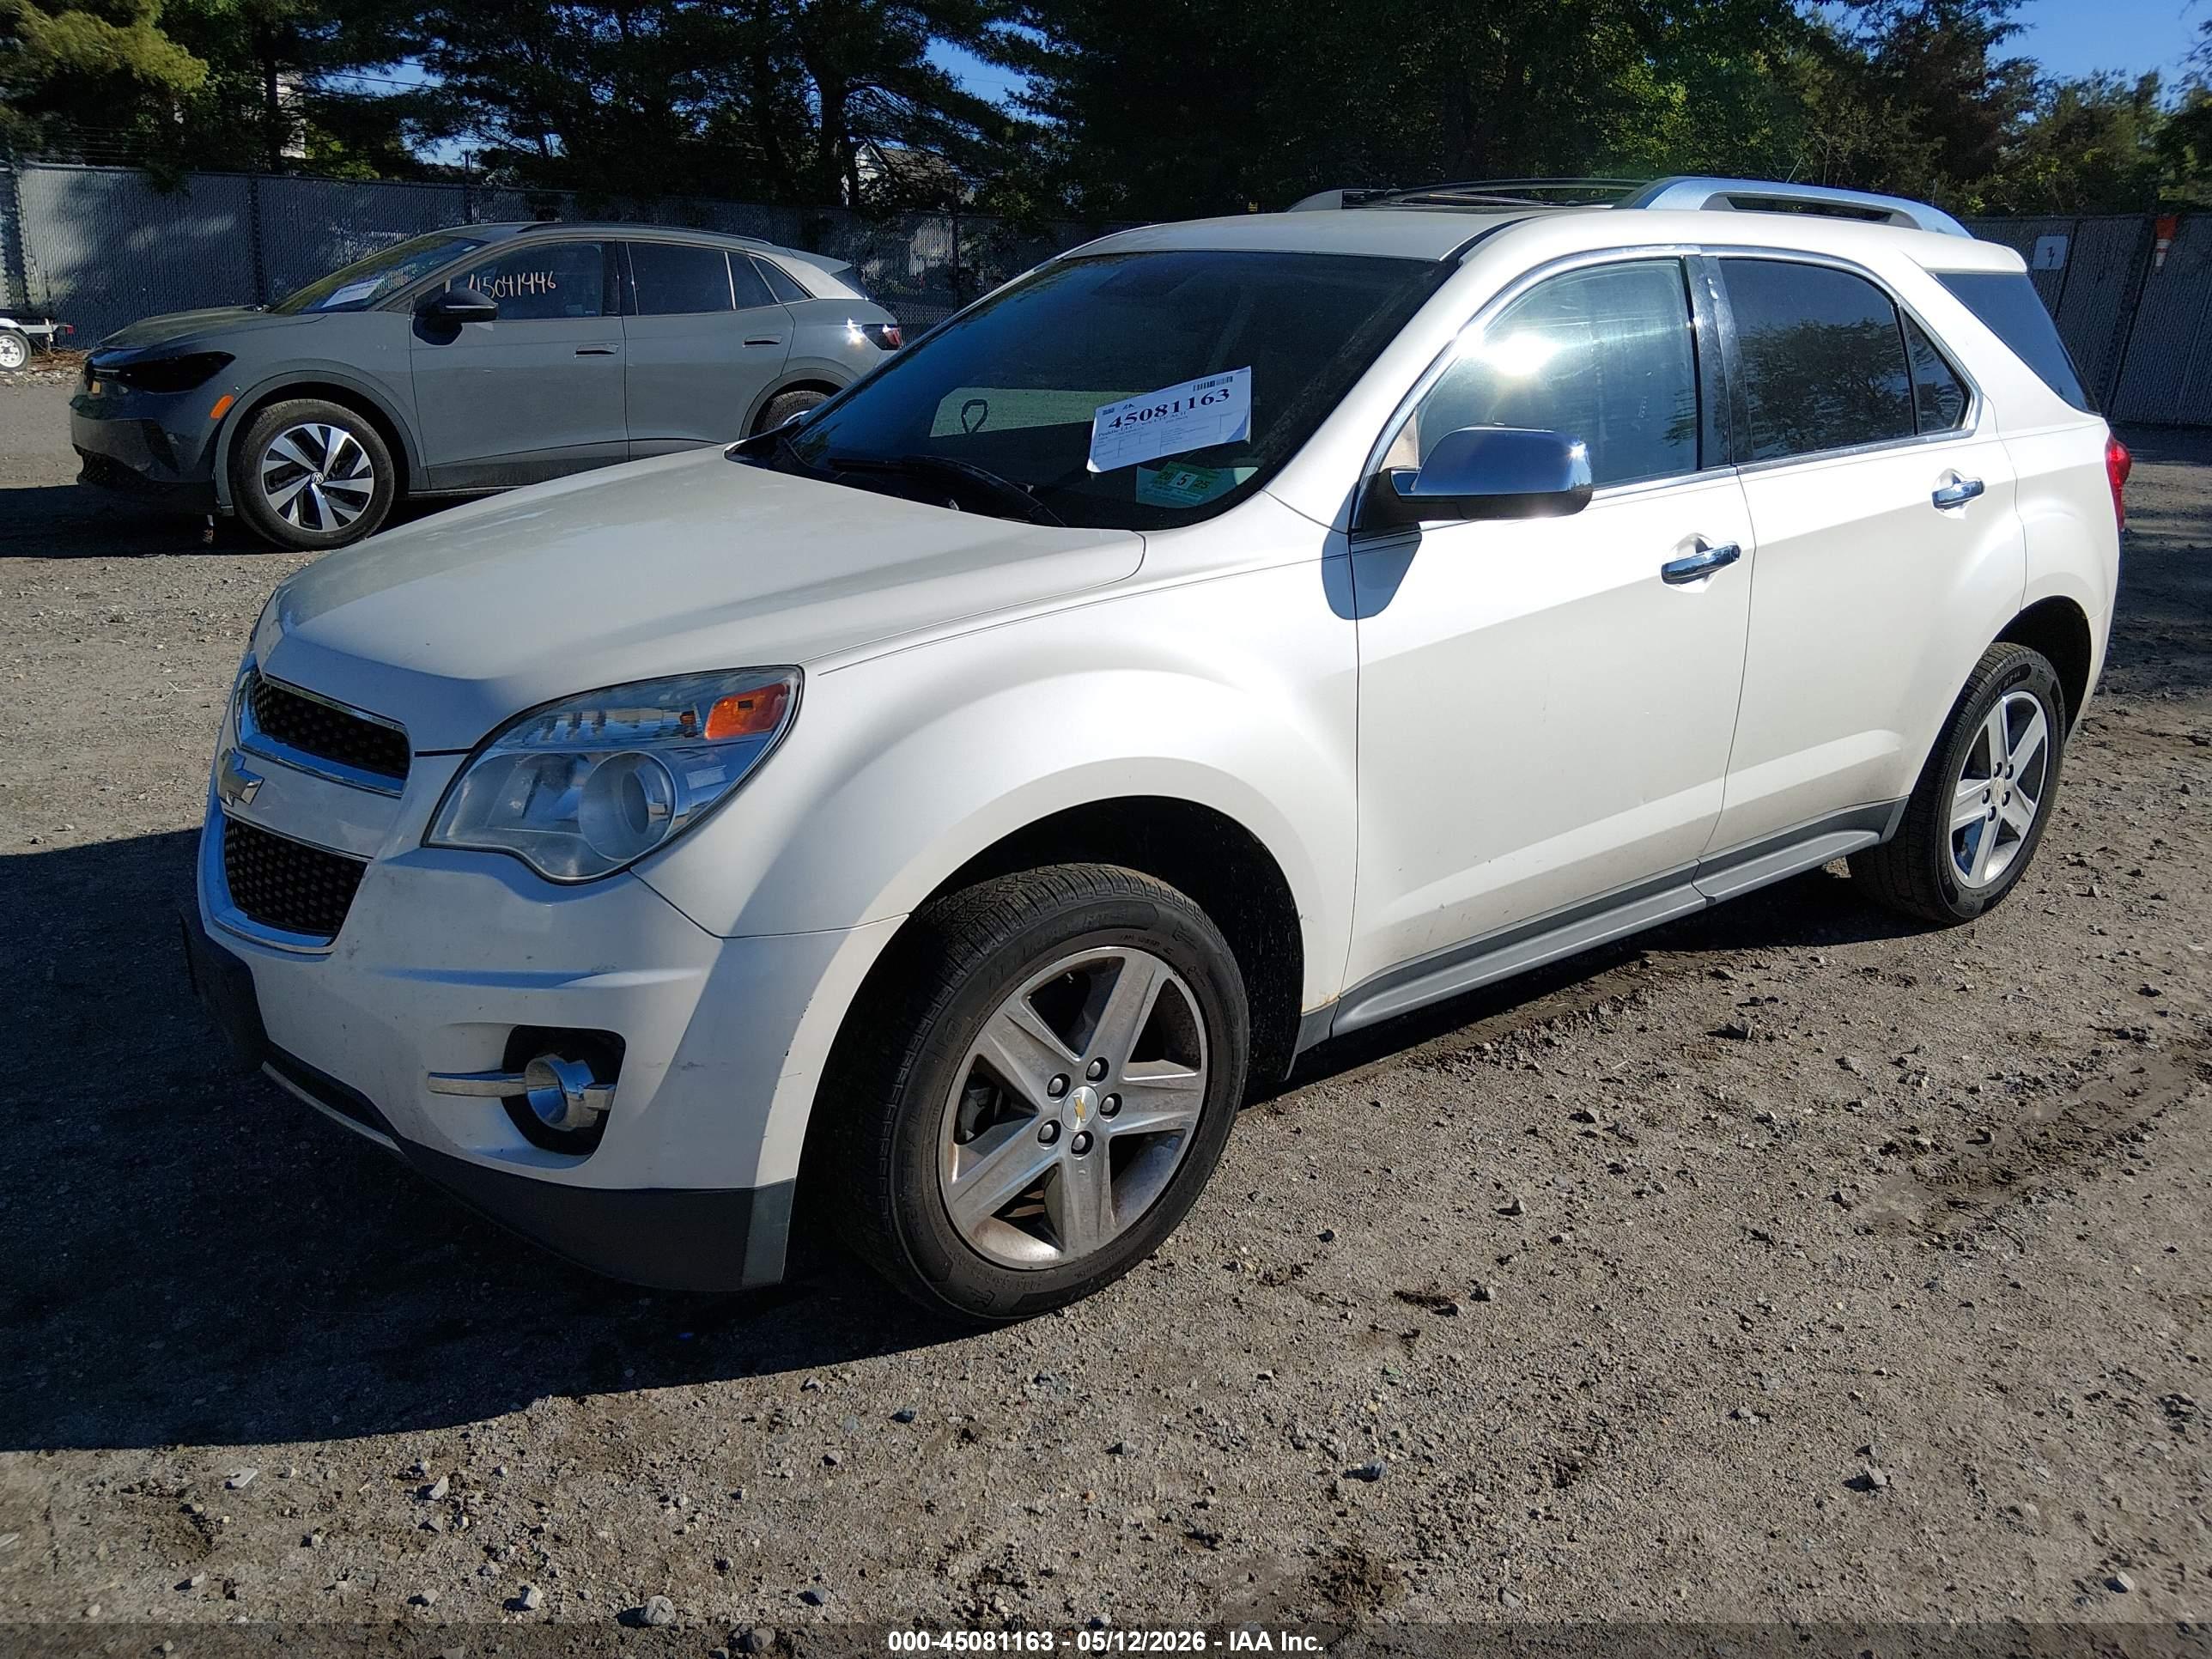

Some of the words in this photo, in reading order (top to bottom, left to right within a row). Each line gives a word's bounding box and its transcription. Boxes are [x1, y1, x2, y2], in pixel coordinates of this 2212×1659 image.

[1109, 388, 1230, 428] 45081163
[1176, 474, 1191, 487] 5
[1194, 480, 1211, 489] 25
